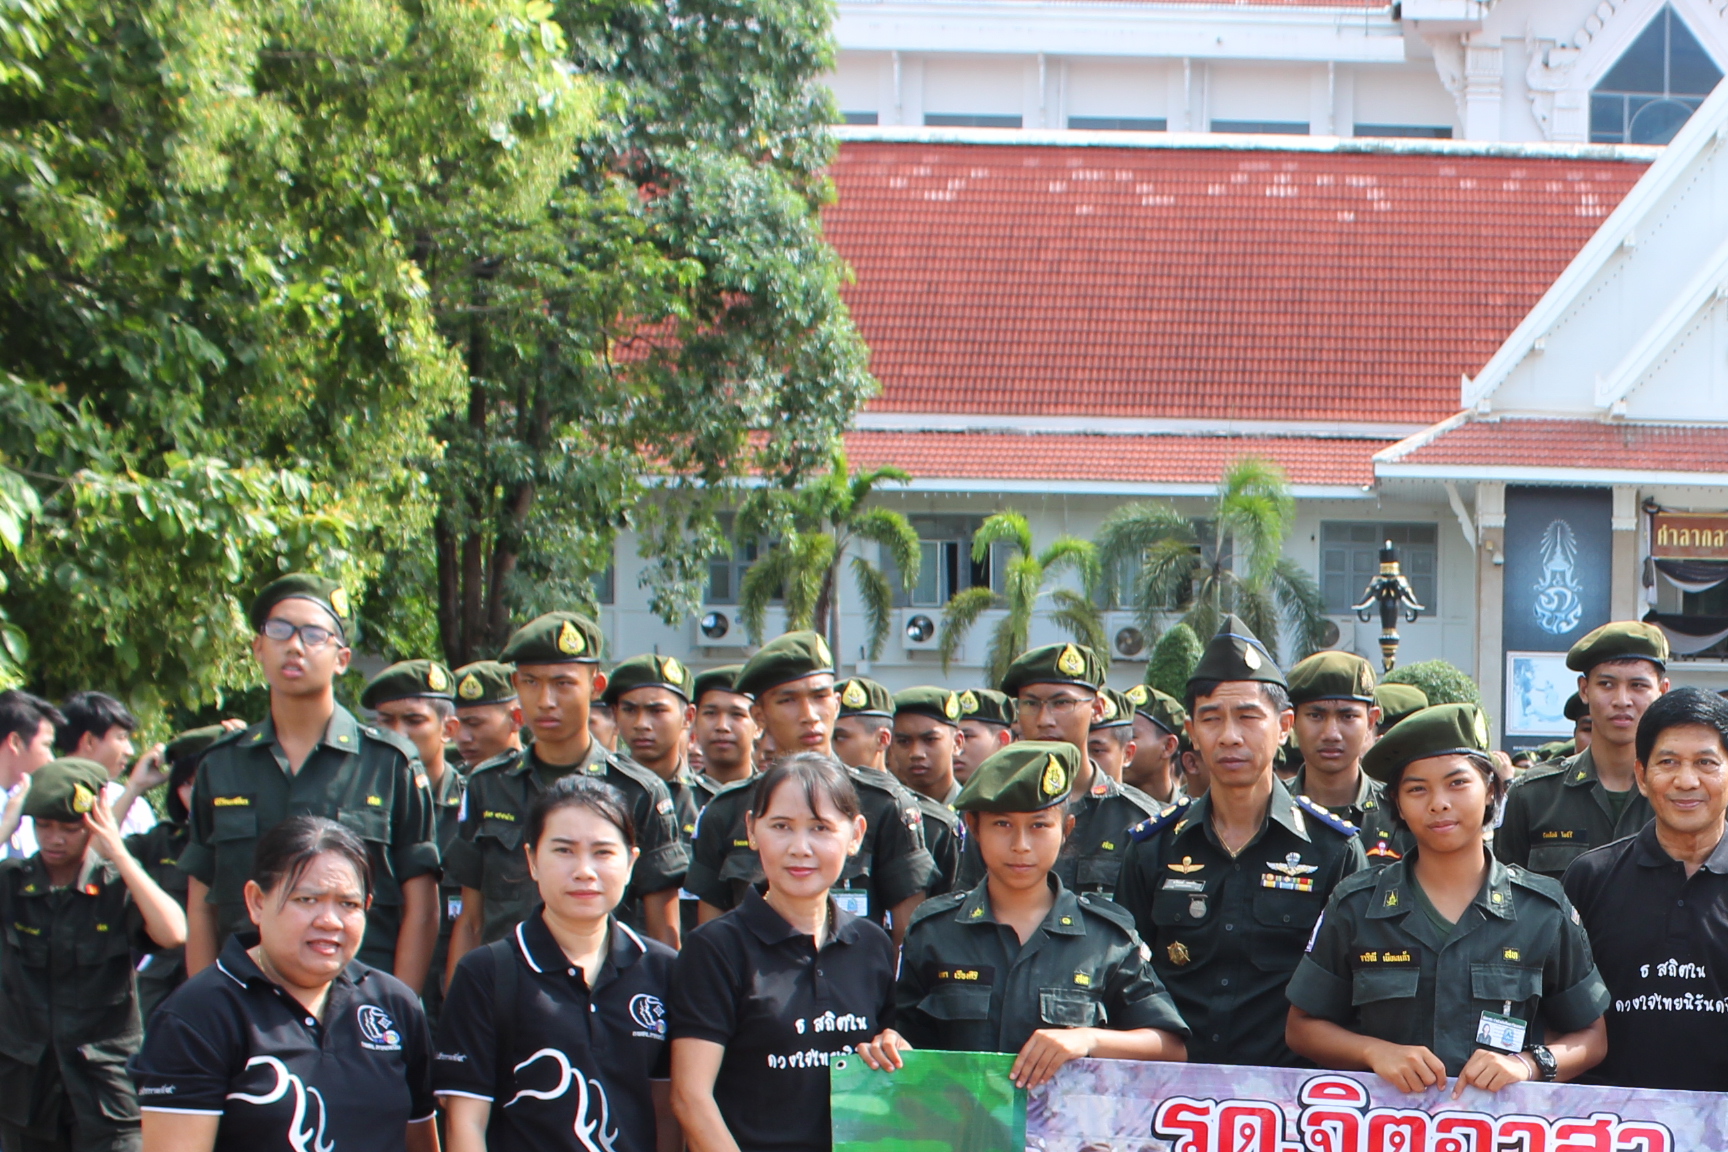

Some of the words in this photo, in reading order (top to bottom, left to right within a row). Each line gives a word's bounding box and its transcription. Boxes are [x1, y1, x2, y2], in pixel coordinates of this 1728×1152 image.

[1639, 963, 1651, 979] ธ
[1656, 957, 1707, 980] สถิตใน
[794, 1017, 806, 1034] ธ
[813, 1010, 869, 1033] สถิตใน
